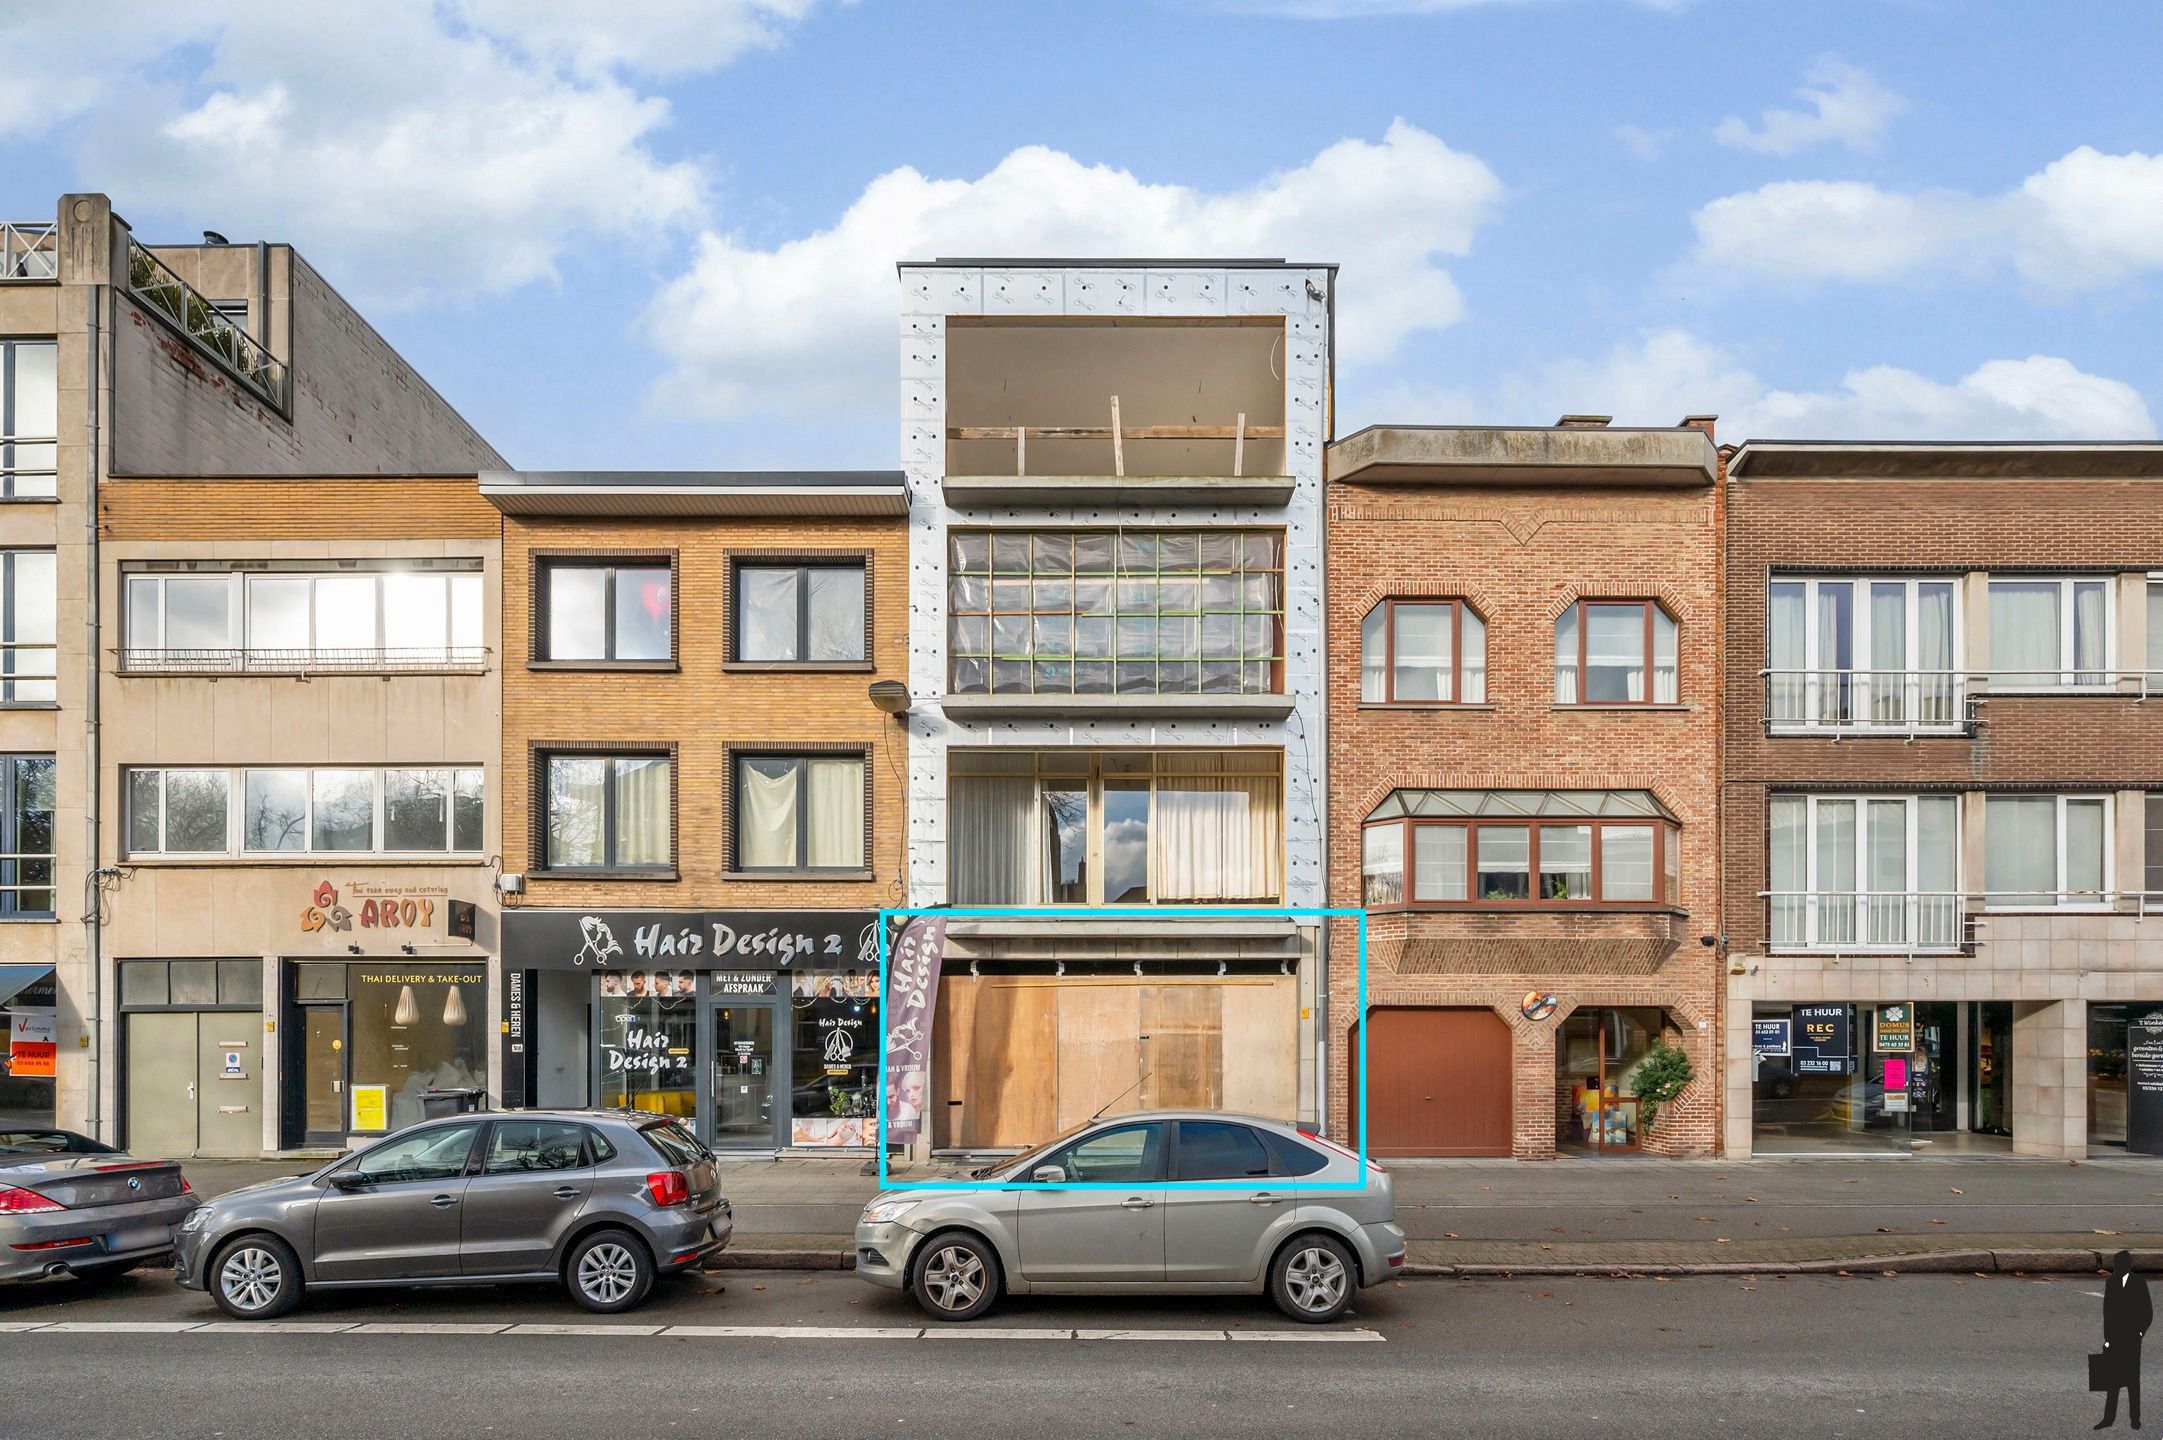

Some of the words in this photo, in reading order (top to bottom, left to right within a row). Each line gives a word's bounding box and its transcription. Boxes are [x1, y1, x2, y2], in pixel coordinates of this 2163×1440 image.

[359, 898, 434, 928] AROY
[634, 923, 704, 959] Hair
[712, 922, 816, 966] Design
[823, 934, 843, 955] 2
[893, 936, 917, 993] Hair
[906, 926, 939, 1009] Design
[361, 974, 383, 984] THAI
[385, 974, 427, 984] DELIVERY
[428, 974, 435, 984] &
[437, 974, 482, 984] TAKE-OUT
[716, 972, 731, 983] MET
[733, 973, 739, 983] &
[741, 972, 772, 983] ZONDER
[510, 972, 521, 1002] DAMES
[723, 983, 765, 994] AFSPRAAK
[1800, 1008, 1813, 1017] TE
[1814, 1008, 1843, 1017] HUUR
[510, 1010, 521, 1038] HEREN
[818, 1017, 836, 1027] Hair
[837, 1017, 863, 1028] Design
[1806, 1023, 1835, 1033] REC
[627, 1028, 669, 1050] Hair
[28, 1050, 50, 1058] HUUR
[608, 1049, 671, 1076] Design
[676, 1056, 688, 1069] 2
[901, 1064, 921, 1072] VROUW
